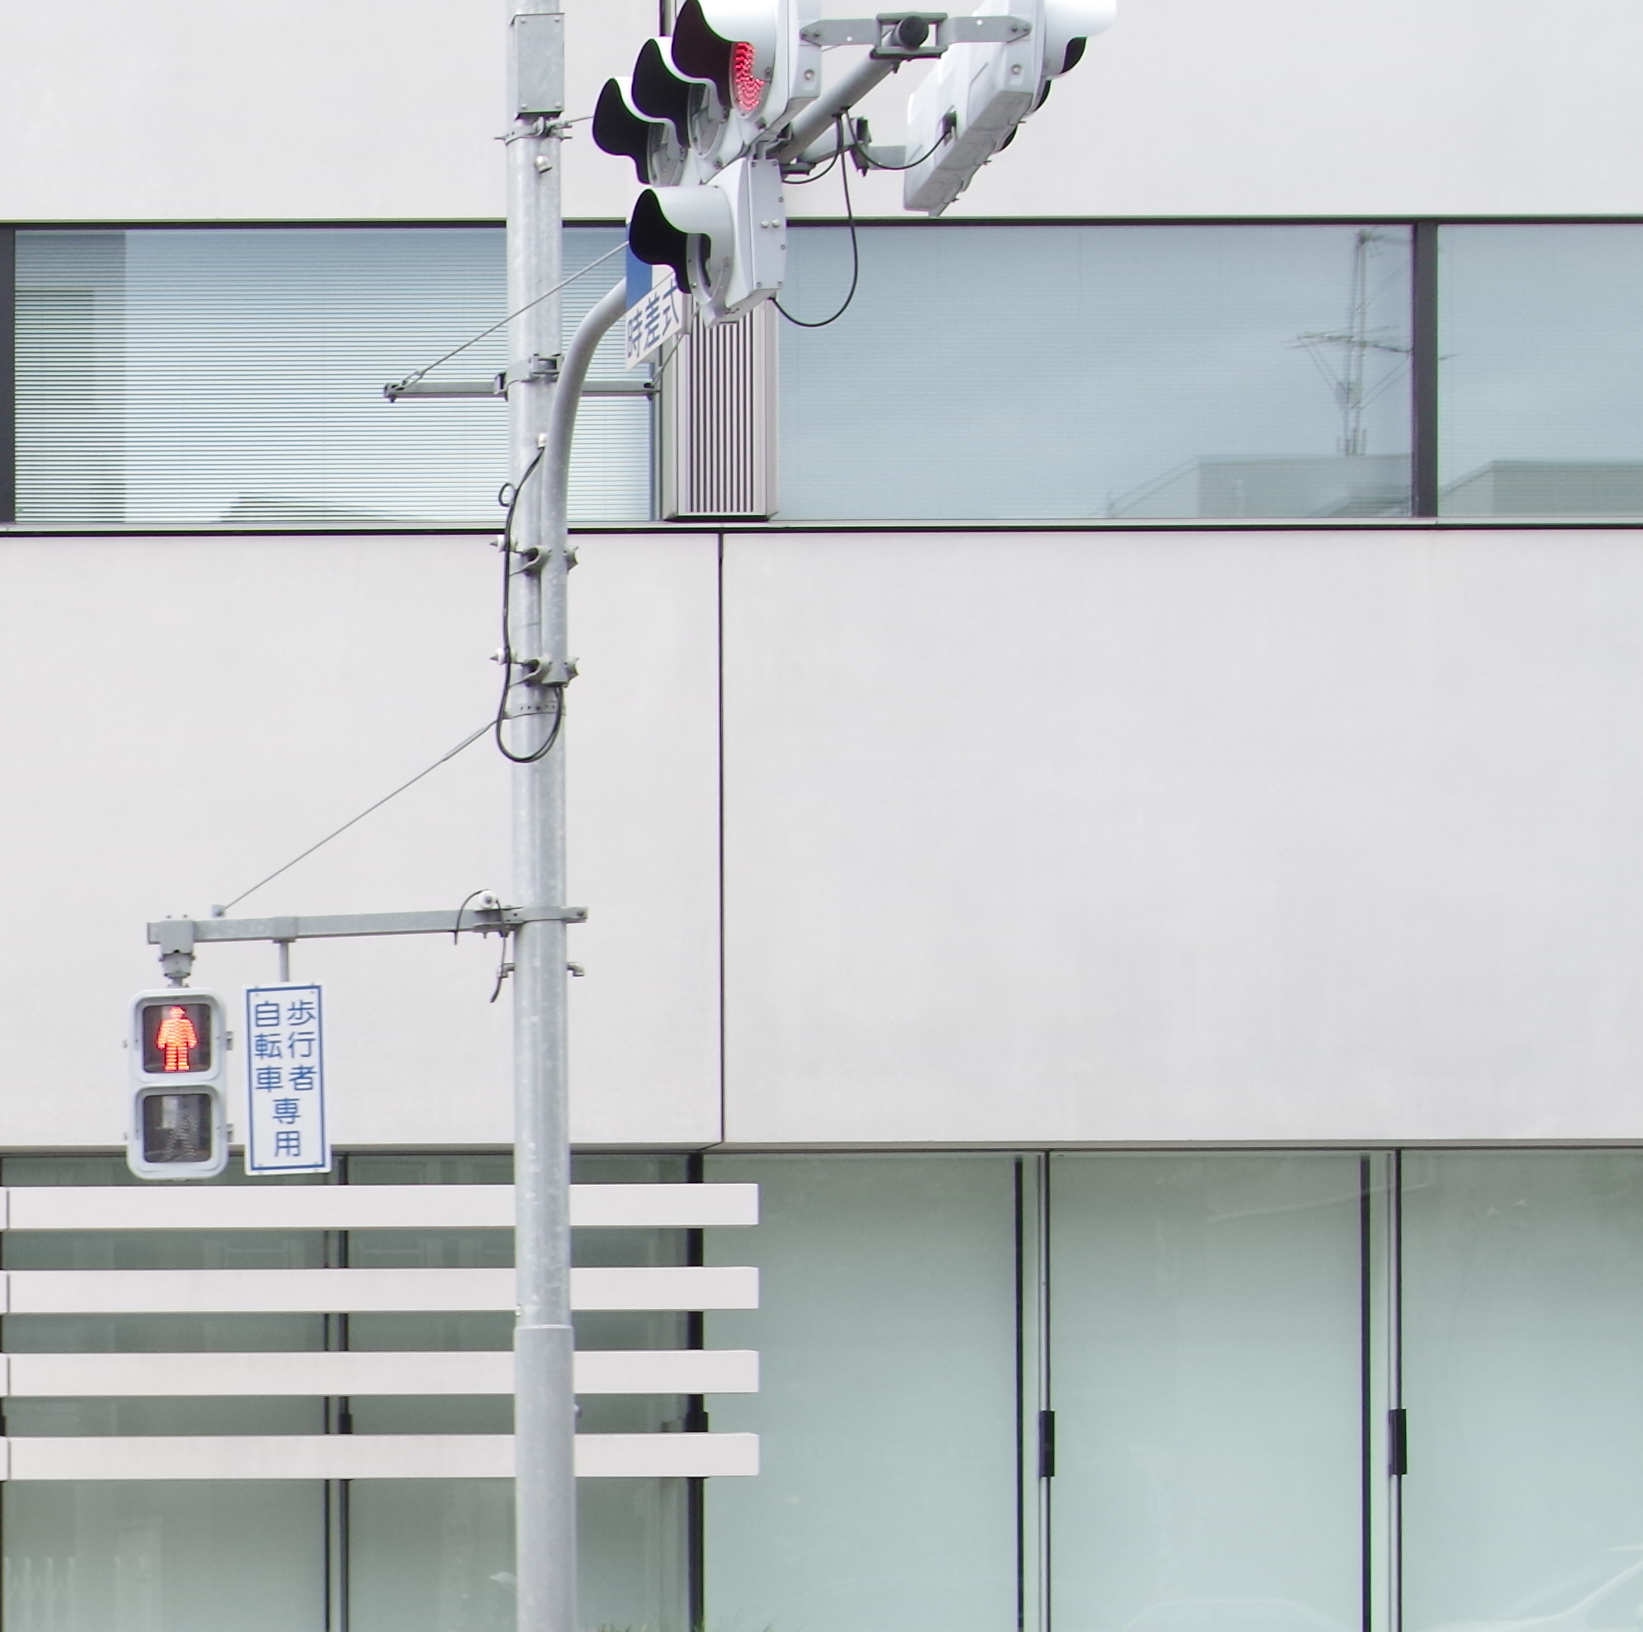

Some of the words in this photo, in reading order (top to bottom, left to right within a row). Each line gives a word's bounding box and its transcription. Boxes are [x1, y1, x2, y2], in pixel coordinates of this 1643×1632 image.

[627, 279, 679, 358] 時差式
[254, 1000, 284, 1093] 自転車
[287, 1000, 317, 1092] 歩行者
[272, 1097, 302, 1158] 専用
